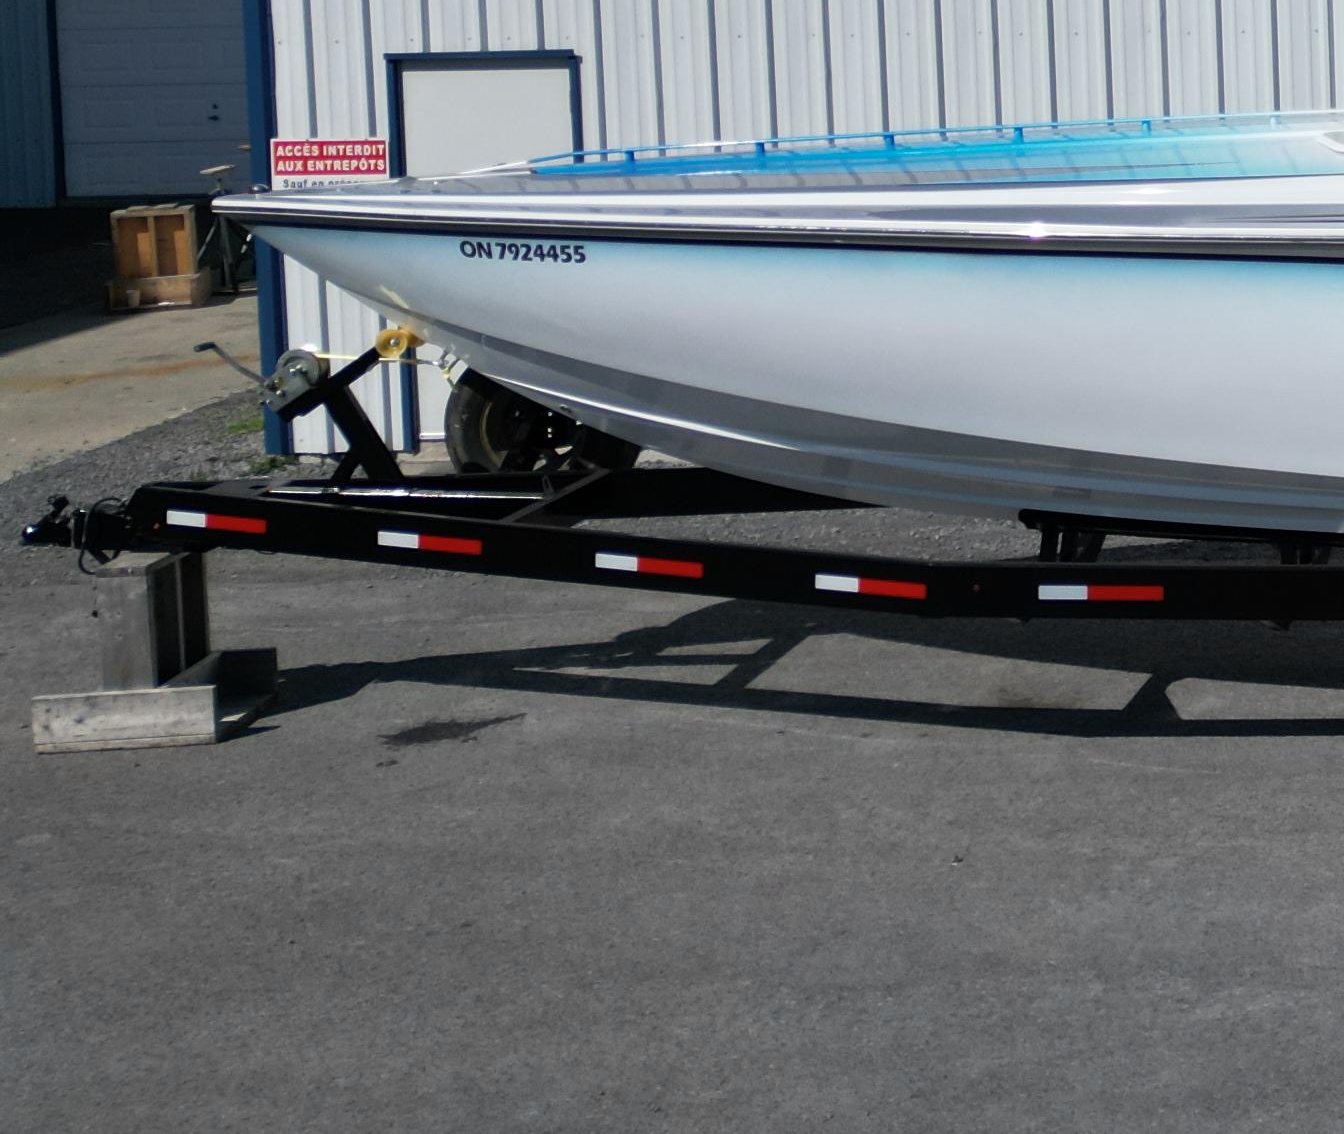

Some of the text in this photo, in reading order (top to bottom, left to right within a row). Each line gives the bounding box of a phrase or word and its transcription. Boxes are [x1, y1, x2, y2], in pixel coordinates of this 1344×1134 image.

[276, 143, 385, 157] ACCÈS INTERDIT
[277, 158, 385, 172] AUX ENTREPÔTS
